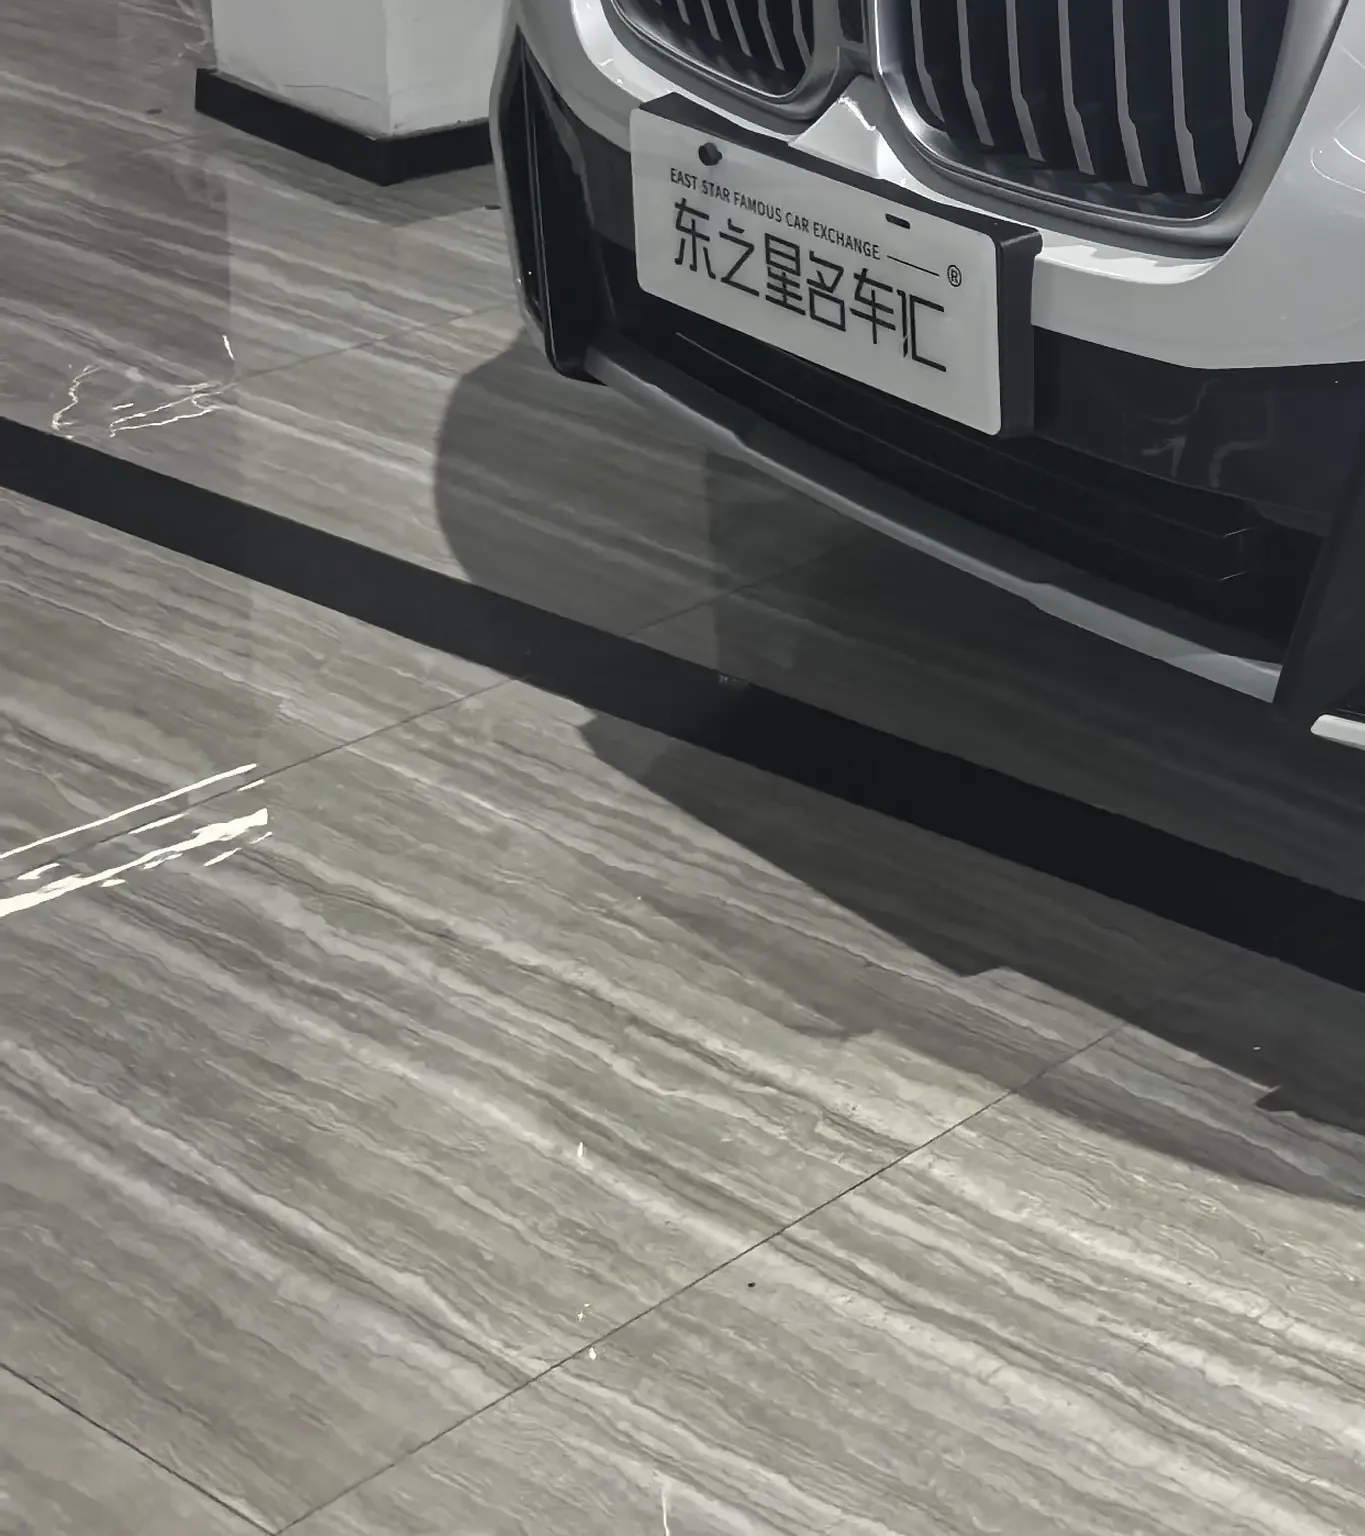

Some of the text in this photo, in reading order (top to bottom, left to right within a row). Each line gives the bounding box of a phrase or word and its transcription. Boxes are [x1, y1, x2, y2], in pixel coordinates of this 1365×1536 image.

[670, 167, 881, 260] EAST STAR FAMOUS CAR EXCHANGE
[674, 198, 947, 372] 东之星名车汇
